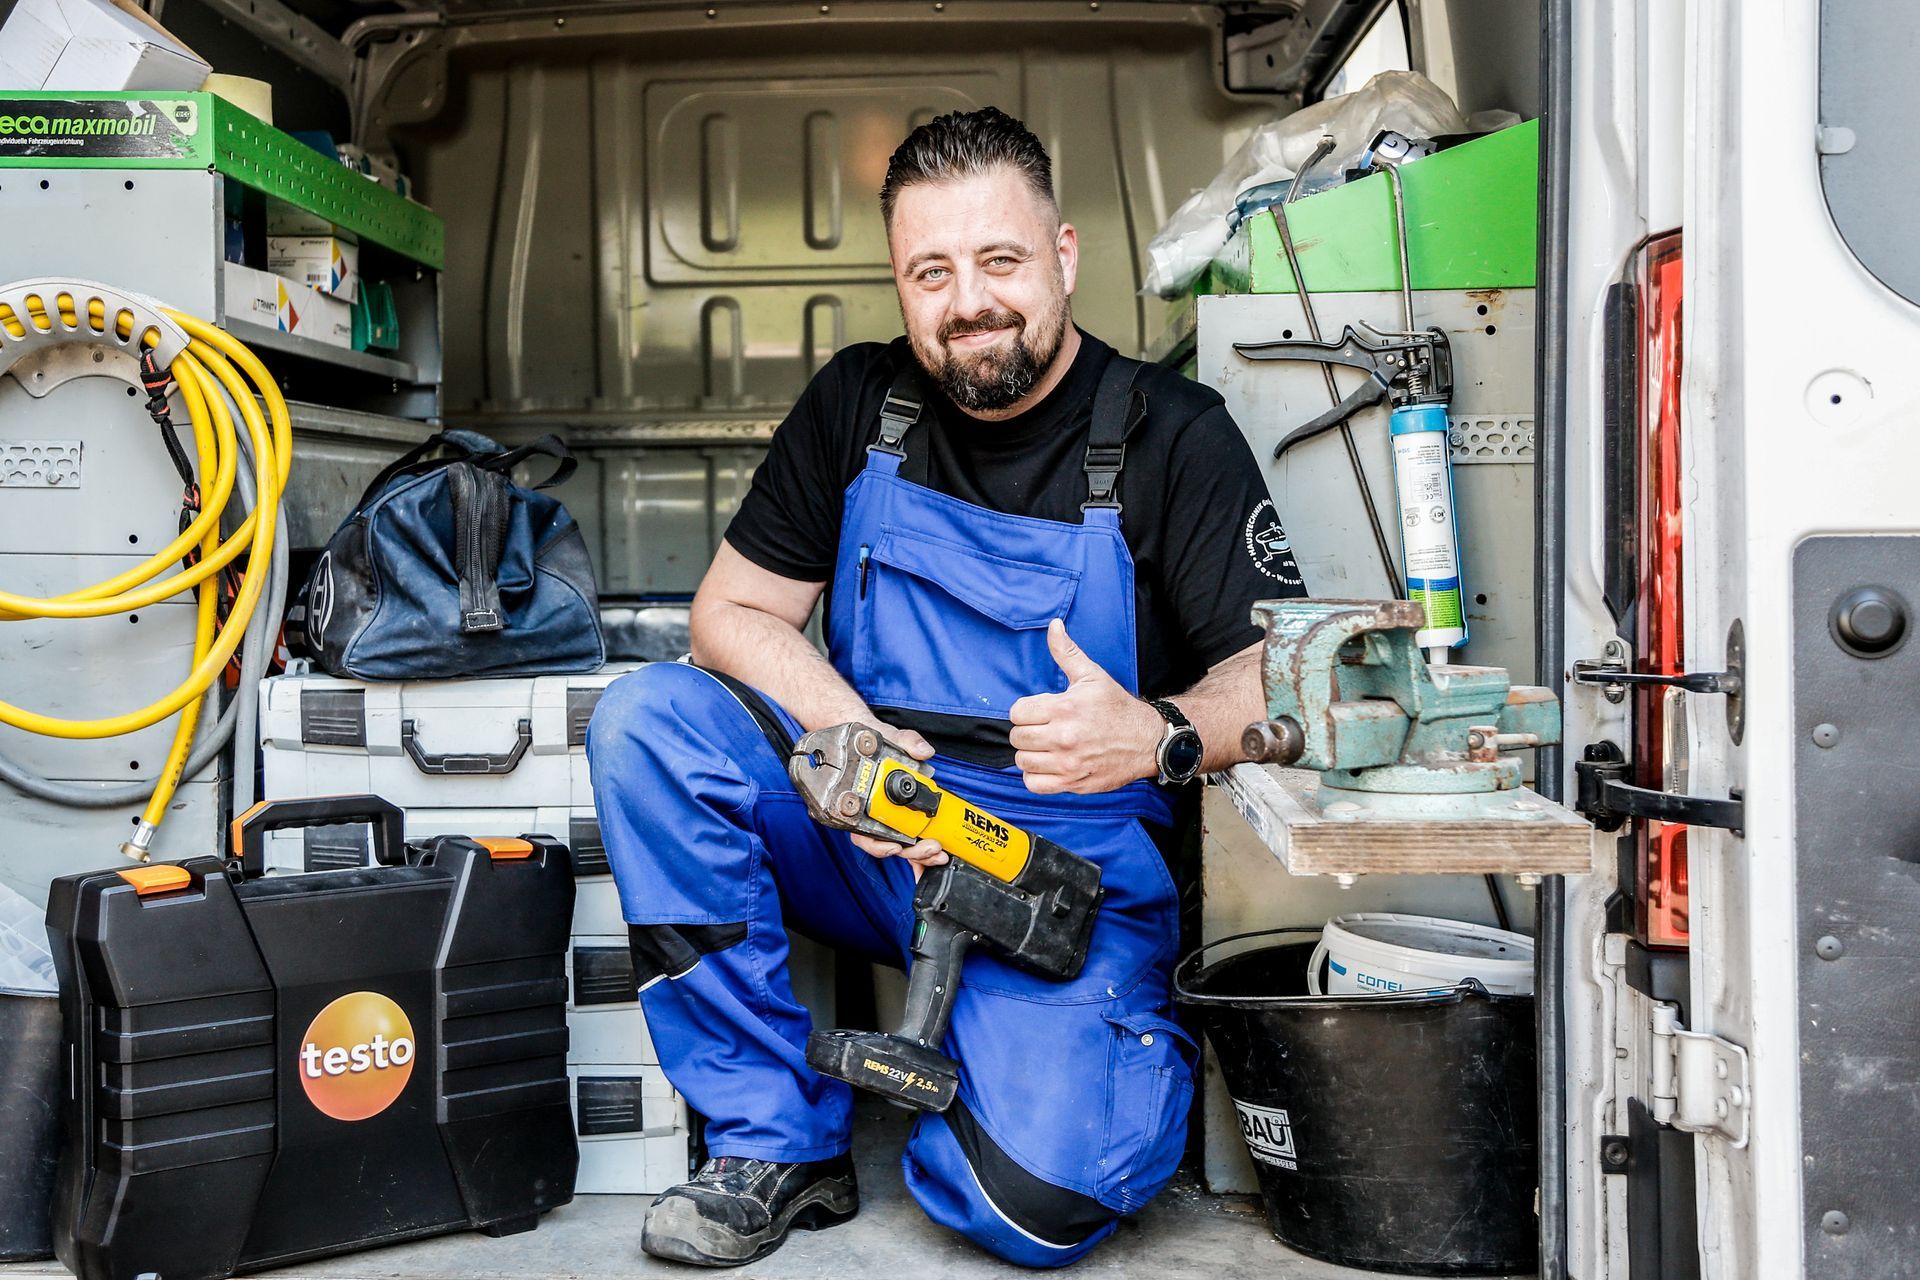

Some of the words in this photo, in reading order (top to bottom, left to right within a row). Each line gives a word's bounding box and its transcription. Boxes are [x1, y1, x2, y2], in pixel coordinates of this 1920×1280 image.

[51, 113, 157, 136] maxmobil
[28, 138, 84, 146] Fahrzeugeinrichtung
[1245, 502, 1263, 557] HAUSTECHNIK
[857, 761, 873, 793] REMS
[964, 807, 1009, 842] REMS
[971, 838, 990, 851] ACC
[995, 839, 1007, 849] 22V
[301, 1034, 414, 1078] testo
[1237, 1109, 1287, 1147] BAU
